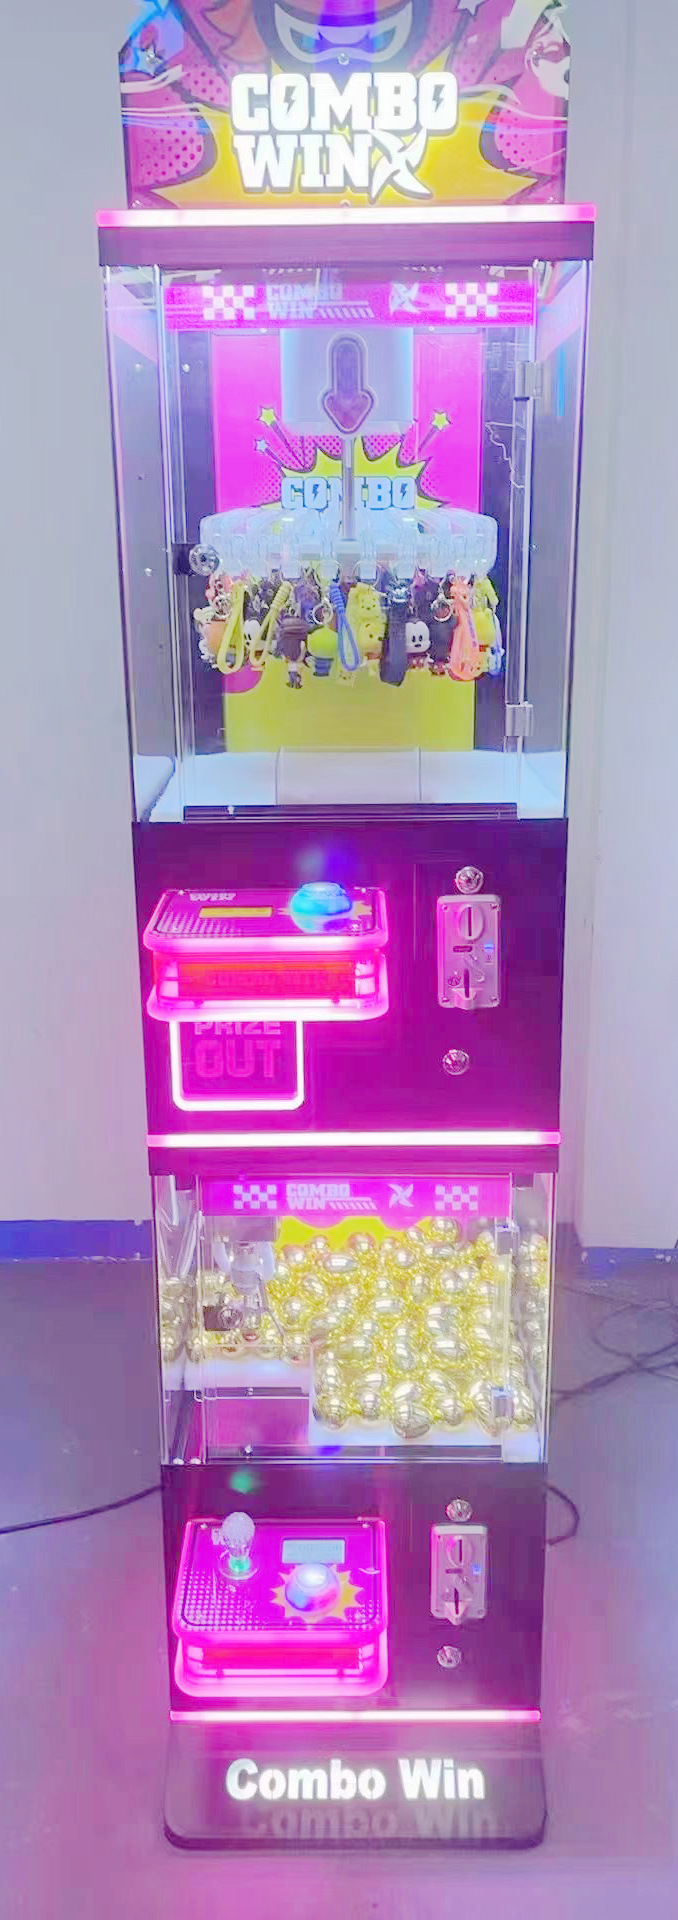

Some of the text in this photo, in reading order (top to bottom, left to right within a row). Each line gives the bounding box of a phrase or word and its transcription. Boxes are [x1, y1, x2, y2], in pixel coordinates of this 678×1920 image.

[231, 72, 458, 131] COMBO
[195, 1039, 281, 1078] OUT
[286, 1183, 350, 1198] COMBO
[286, 1198, 325, 1210] WIN
[226, 1758, 485, 1800] Combo Win
